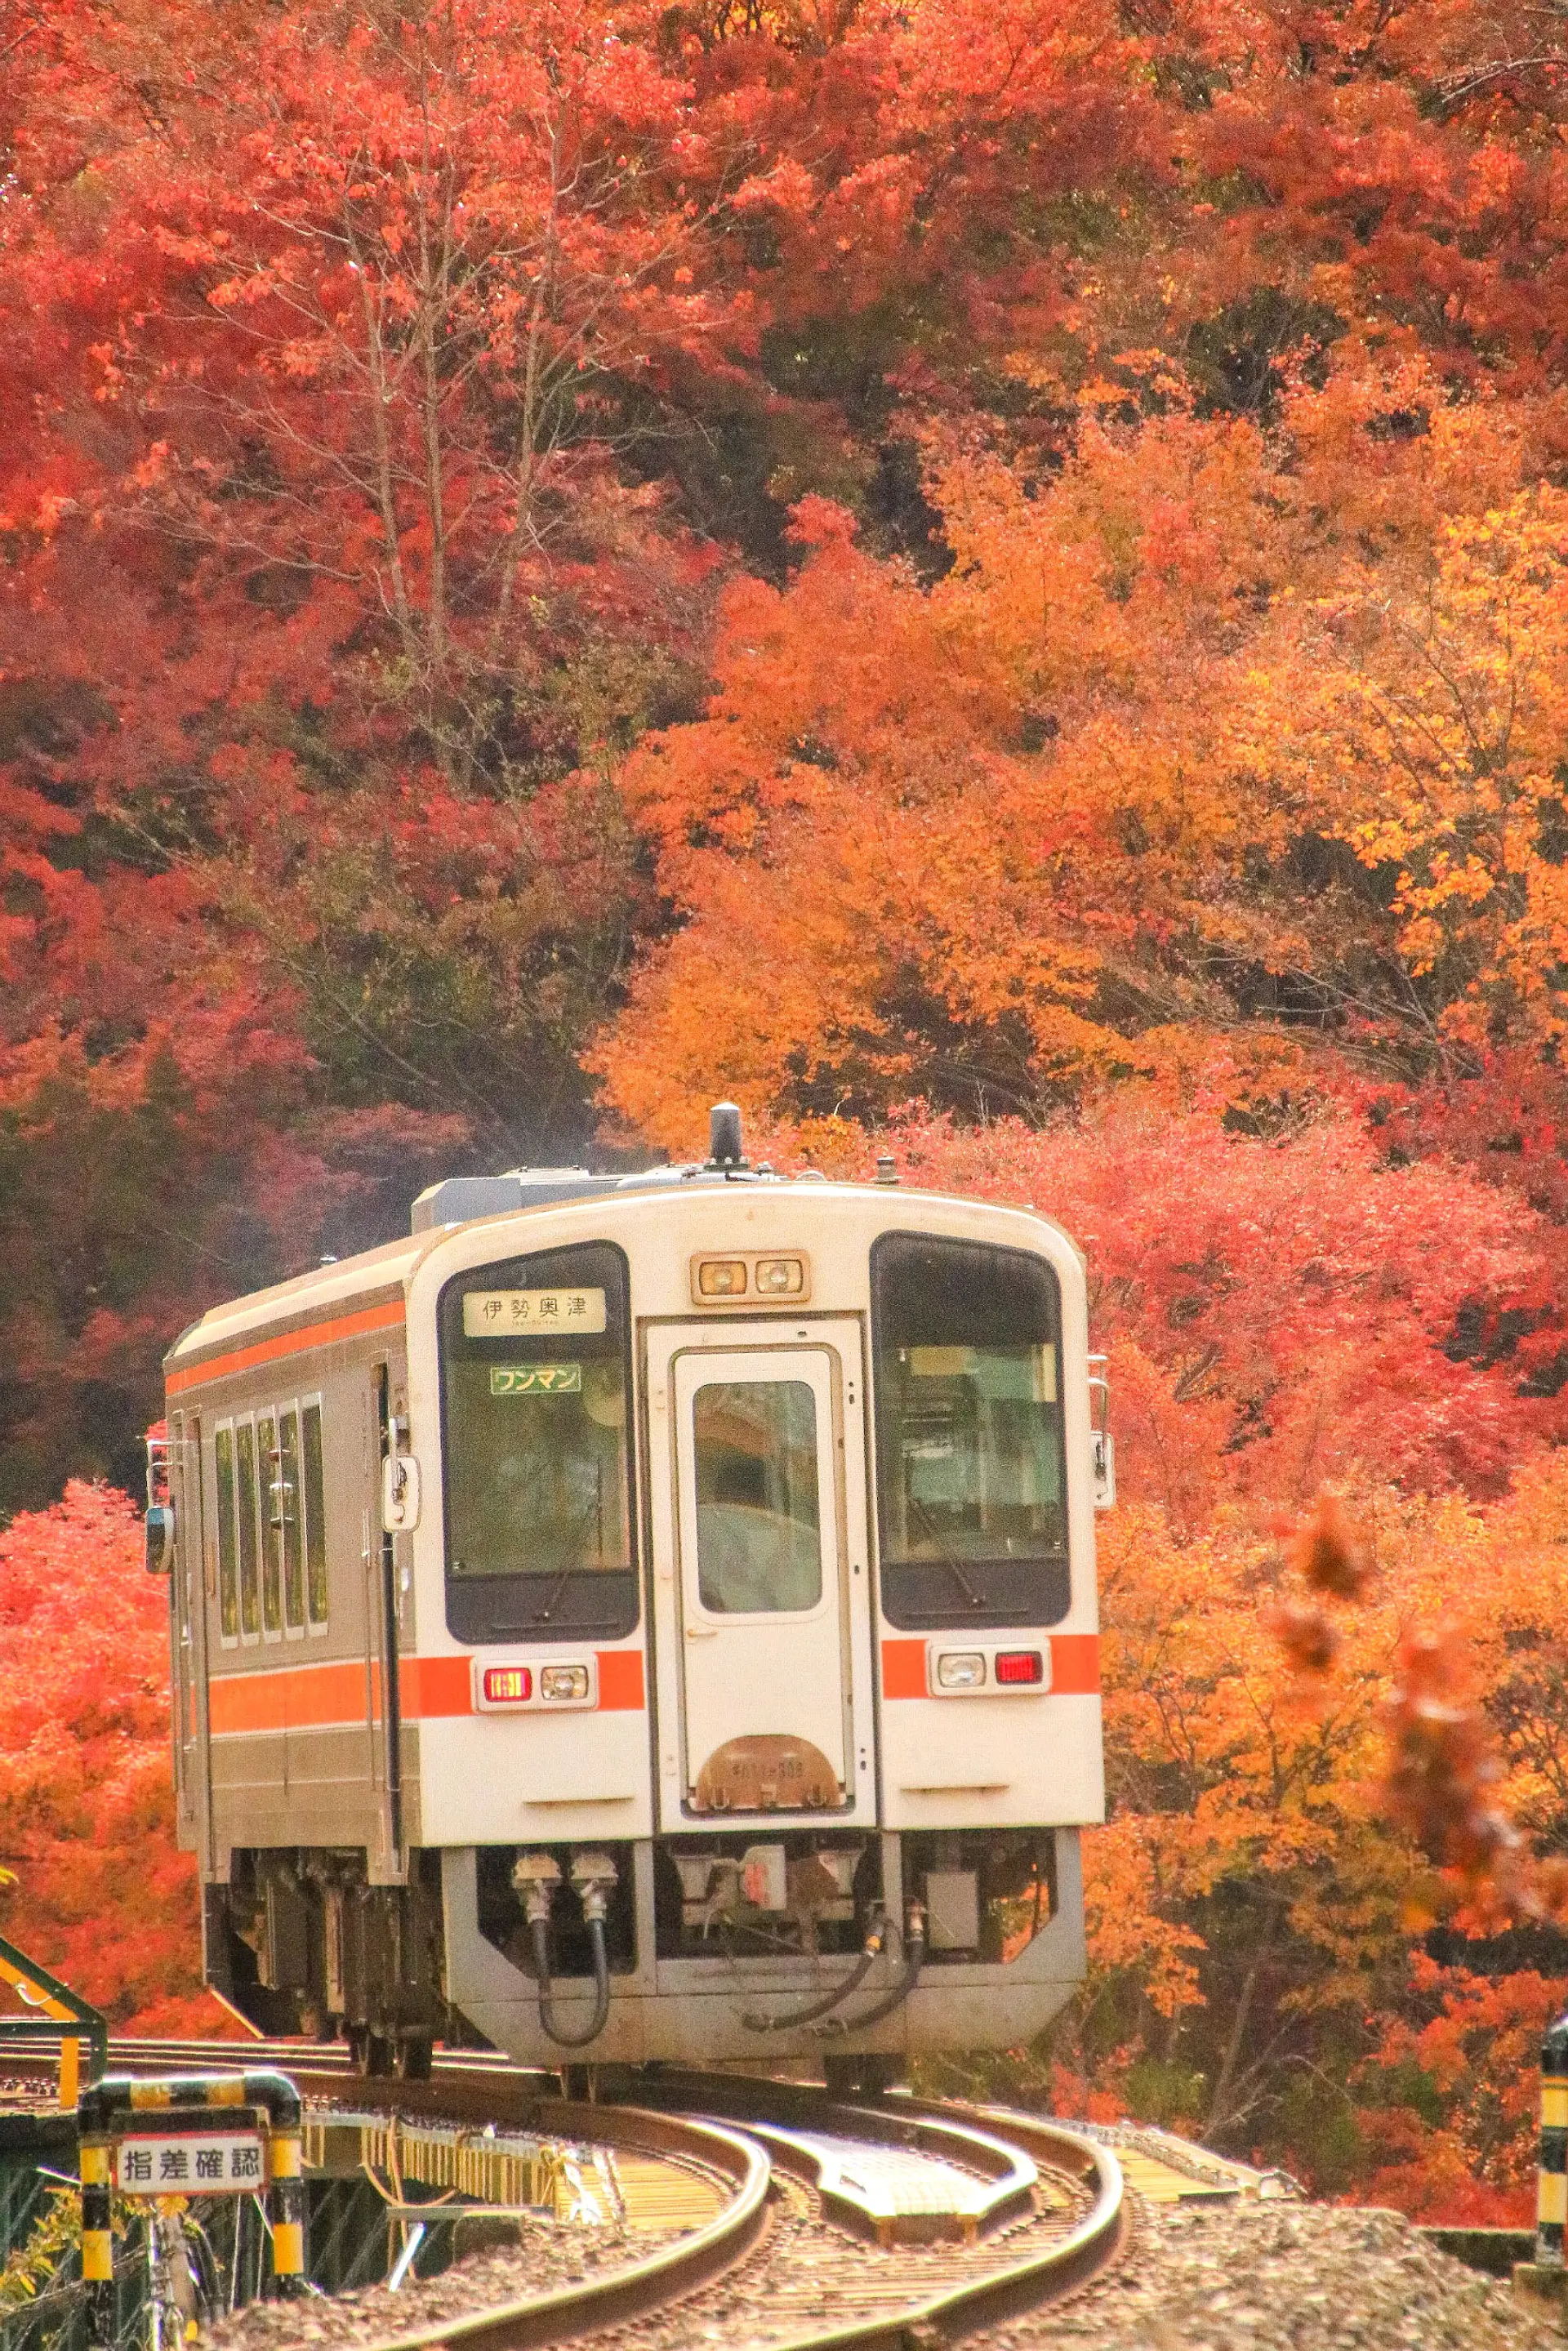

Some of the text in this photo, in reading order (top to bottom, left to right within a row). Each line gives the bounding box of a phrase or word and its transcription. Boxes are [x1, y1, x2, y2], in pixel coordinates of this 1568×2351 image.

[483, 1297, 586, 1320] 伊勢奥津
[495, 1369, 578, 1391] ワンマン
[124, 2147, 261, 2181] 指差確認
